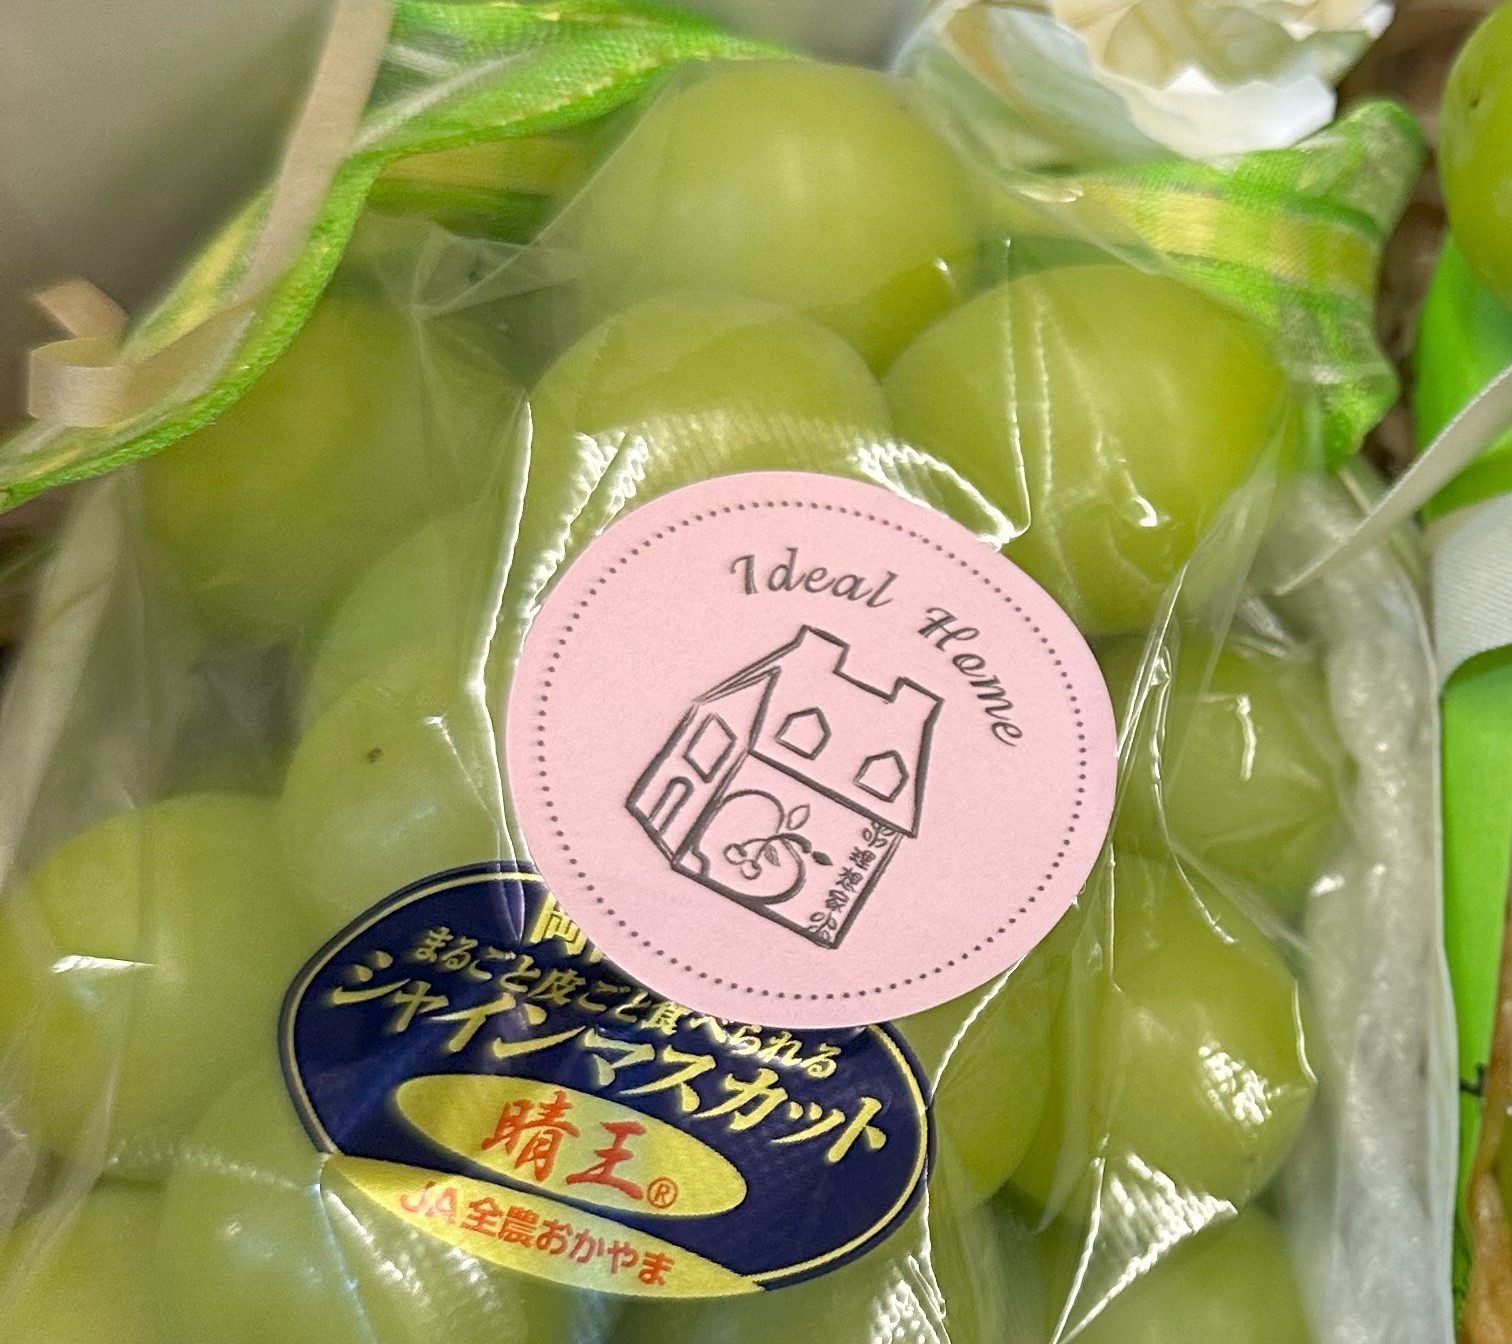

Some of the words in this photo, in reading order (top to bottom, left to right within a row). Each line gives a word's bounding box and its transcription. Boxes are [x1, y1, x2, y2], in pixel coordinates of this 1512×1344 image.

[728, 546, 899, 608] Ideal
[915, 605, 1024, 750] Home
[328, 948, 889, 1166] シャインマスカット
